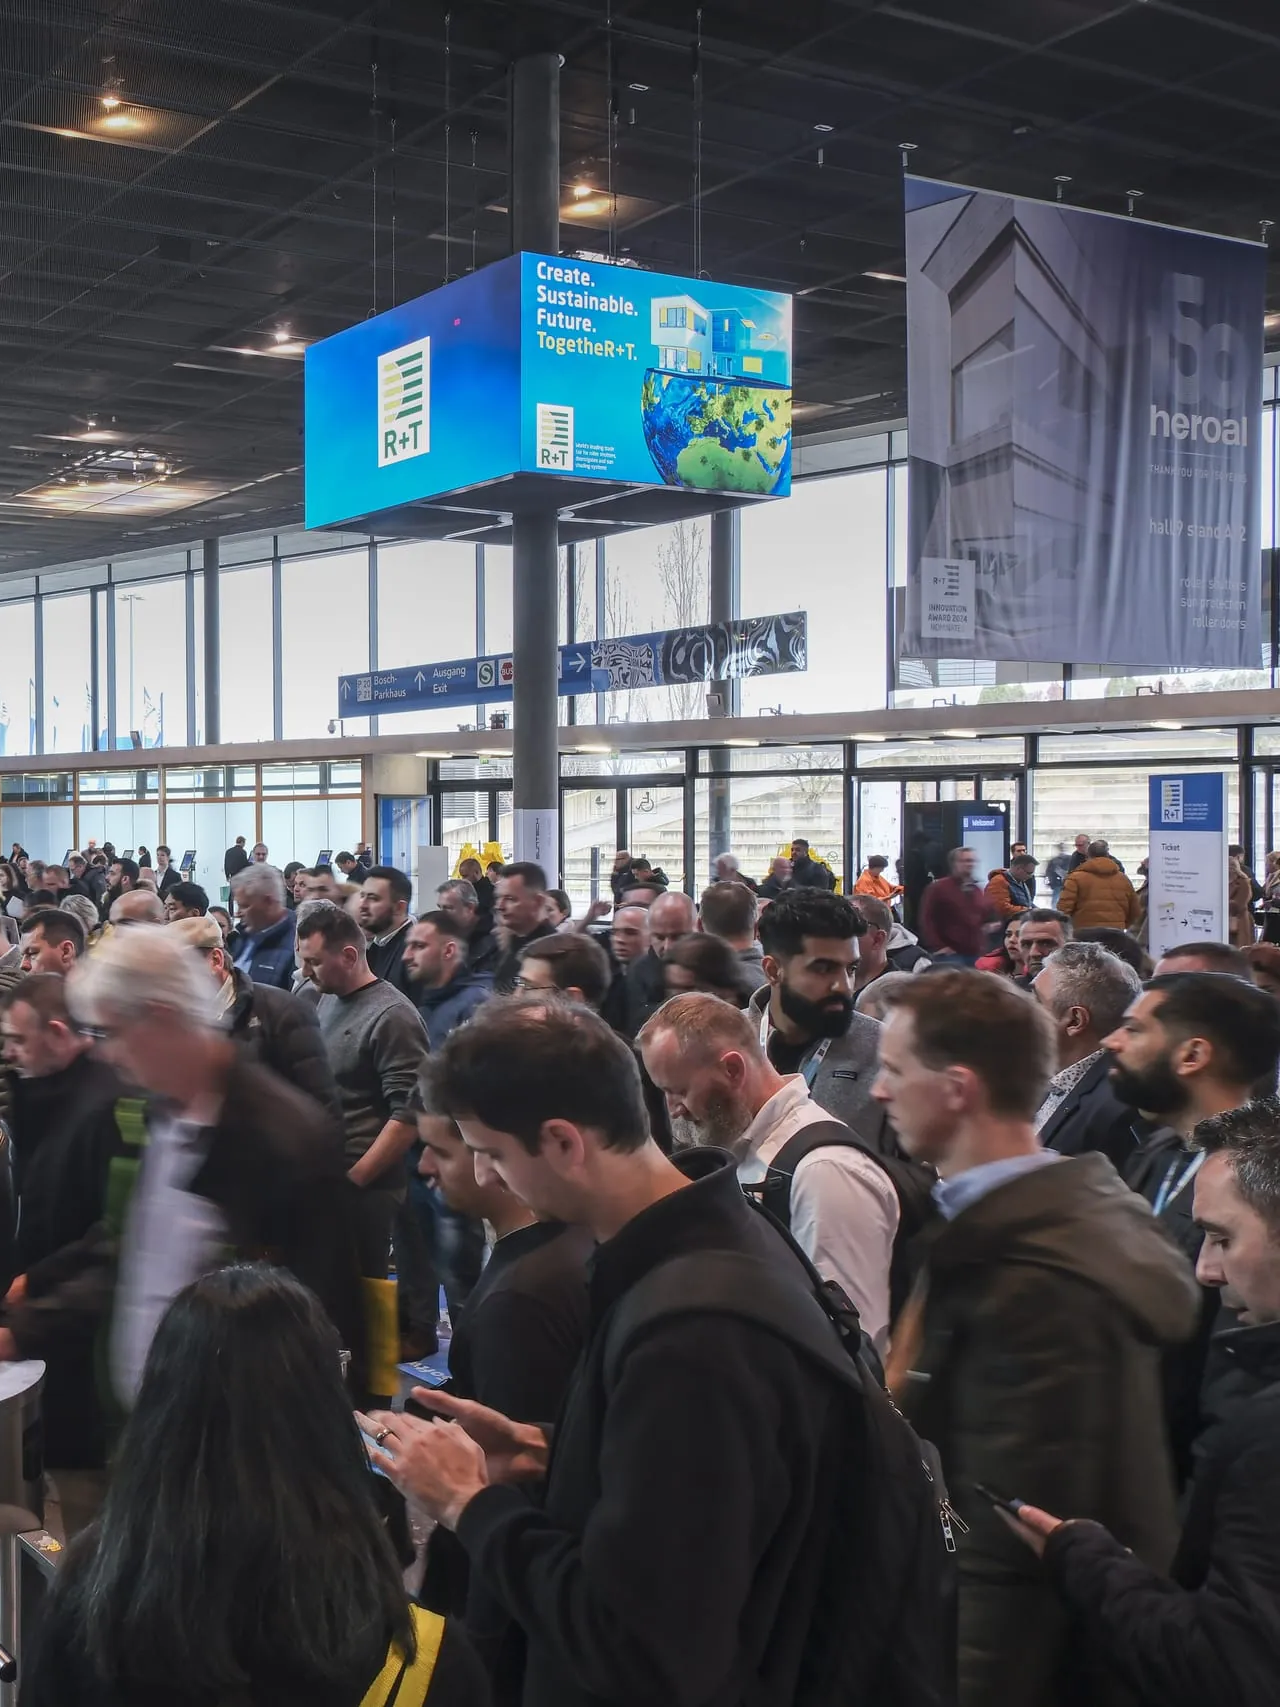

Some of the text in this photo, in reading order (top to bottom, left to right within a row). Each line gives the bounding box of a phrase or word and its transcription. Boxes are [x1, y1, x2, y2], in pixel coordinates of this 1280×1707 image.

[536, 261, 595, 287] Create.
[536, 284, 638, 316] Sustainable.
[536, 307, 596, 333] Future.
[536, 330, 638, 361] TogetheR+T.
[1149, 404, 1248, 447] heroal
[384, 420, 423, 459] R+T
[541, 448, 569, 466] R+T
[928, 603, 967, 612] INNOVATION
[927, 613, 968, 622] AWARD 2024
[432, 667, 466, 679] Ausgang
[373, 674, 398, 686] Bosch-
[373, 688, 406, 700] Parkhaus
[433, 684, 448, 694] Exit
[1164, 809, 1180, 821] R+T
[1161, 843, 1180, 852] Ticket
